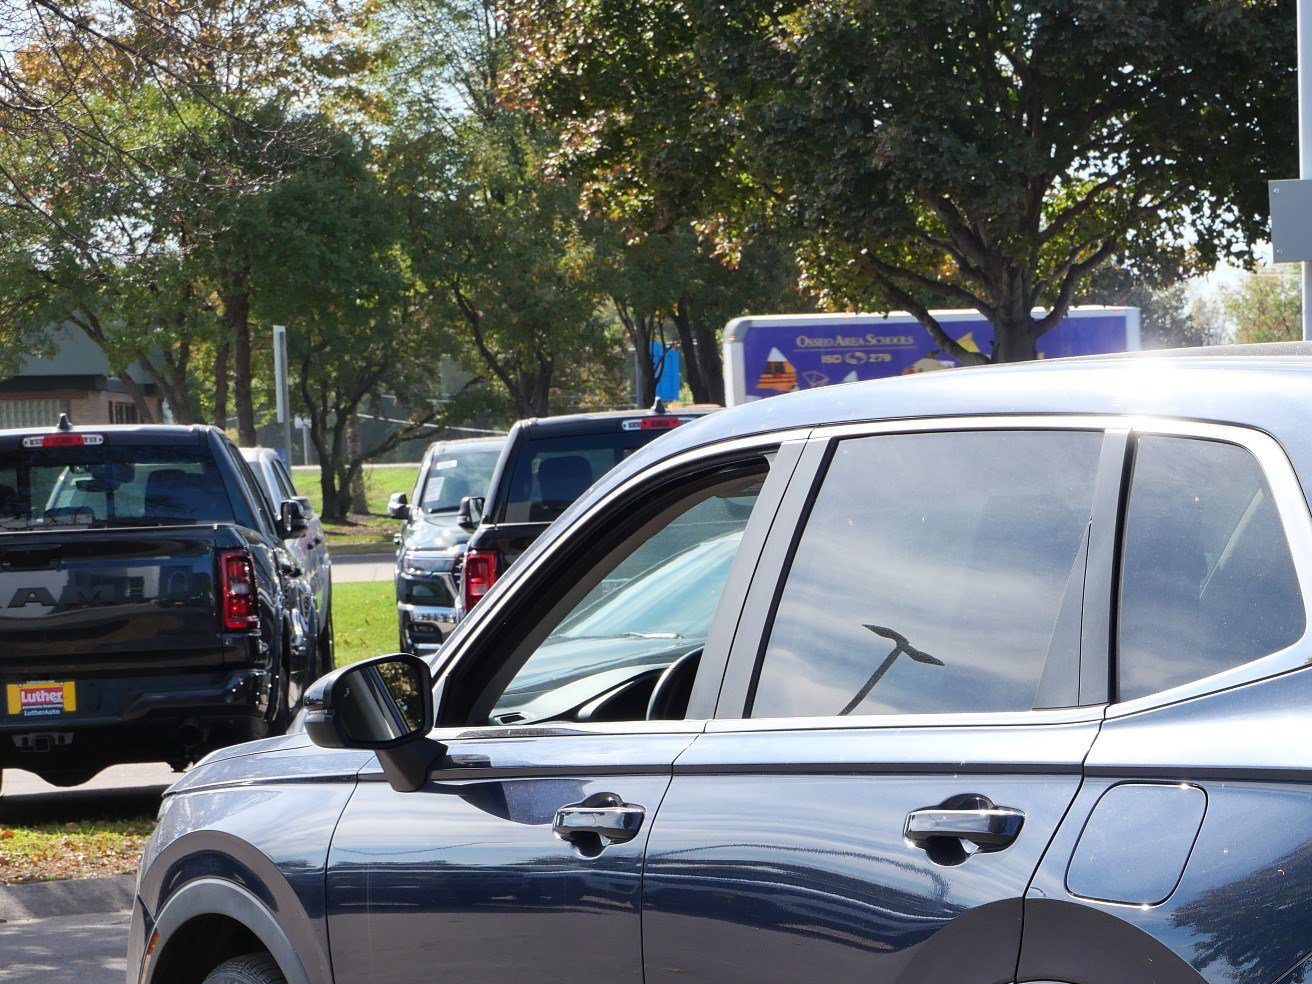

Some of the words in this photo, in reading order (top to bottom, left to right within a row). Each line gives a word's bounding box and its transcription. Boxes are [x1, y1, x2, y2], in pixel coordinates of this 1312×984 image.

[835, 335, 865, 346] AREA
[865, 333, 914, 345] SCHOOLS
[20, 690, 63, 703] Luther
